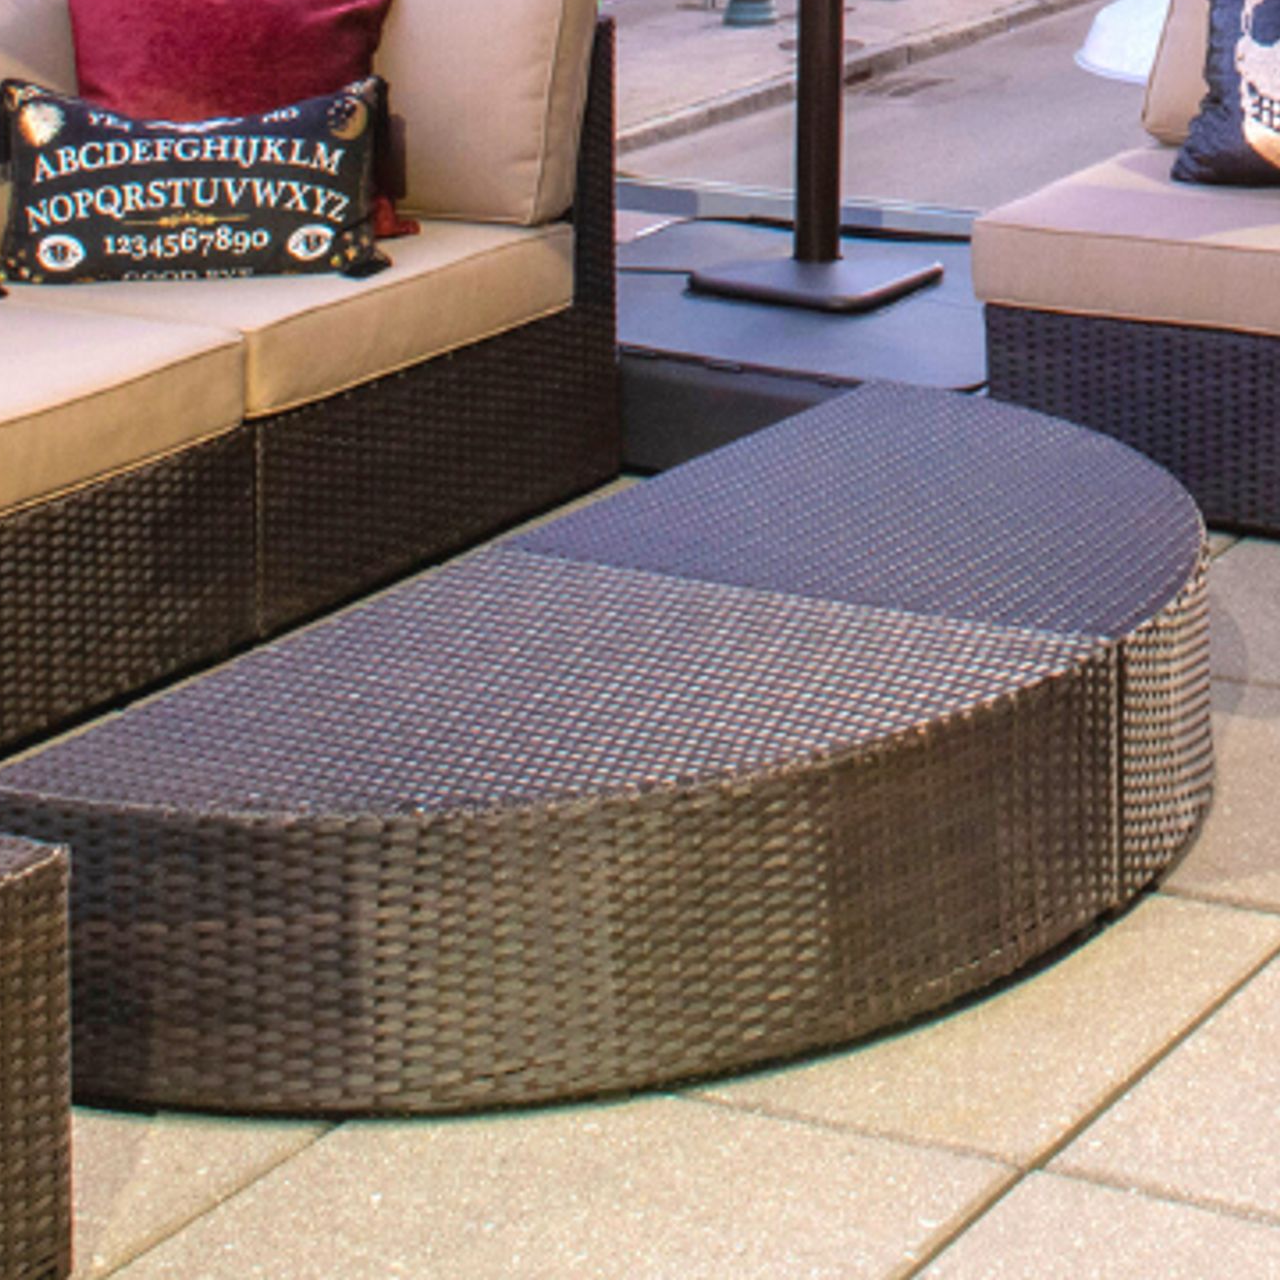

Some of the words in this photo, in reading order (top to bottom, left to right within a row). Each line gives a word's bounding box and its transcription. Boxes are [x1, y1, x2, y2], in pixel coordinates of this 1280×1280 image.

[32, 135, 347, 184] ABCDEFGHIJKLM
[25, 177, 350, 234] NOPQRSTUVWXYZ
[104, 224, 272, 262] 1234567890
